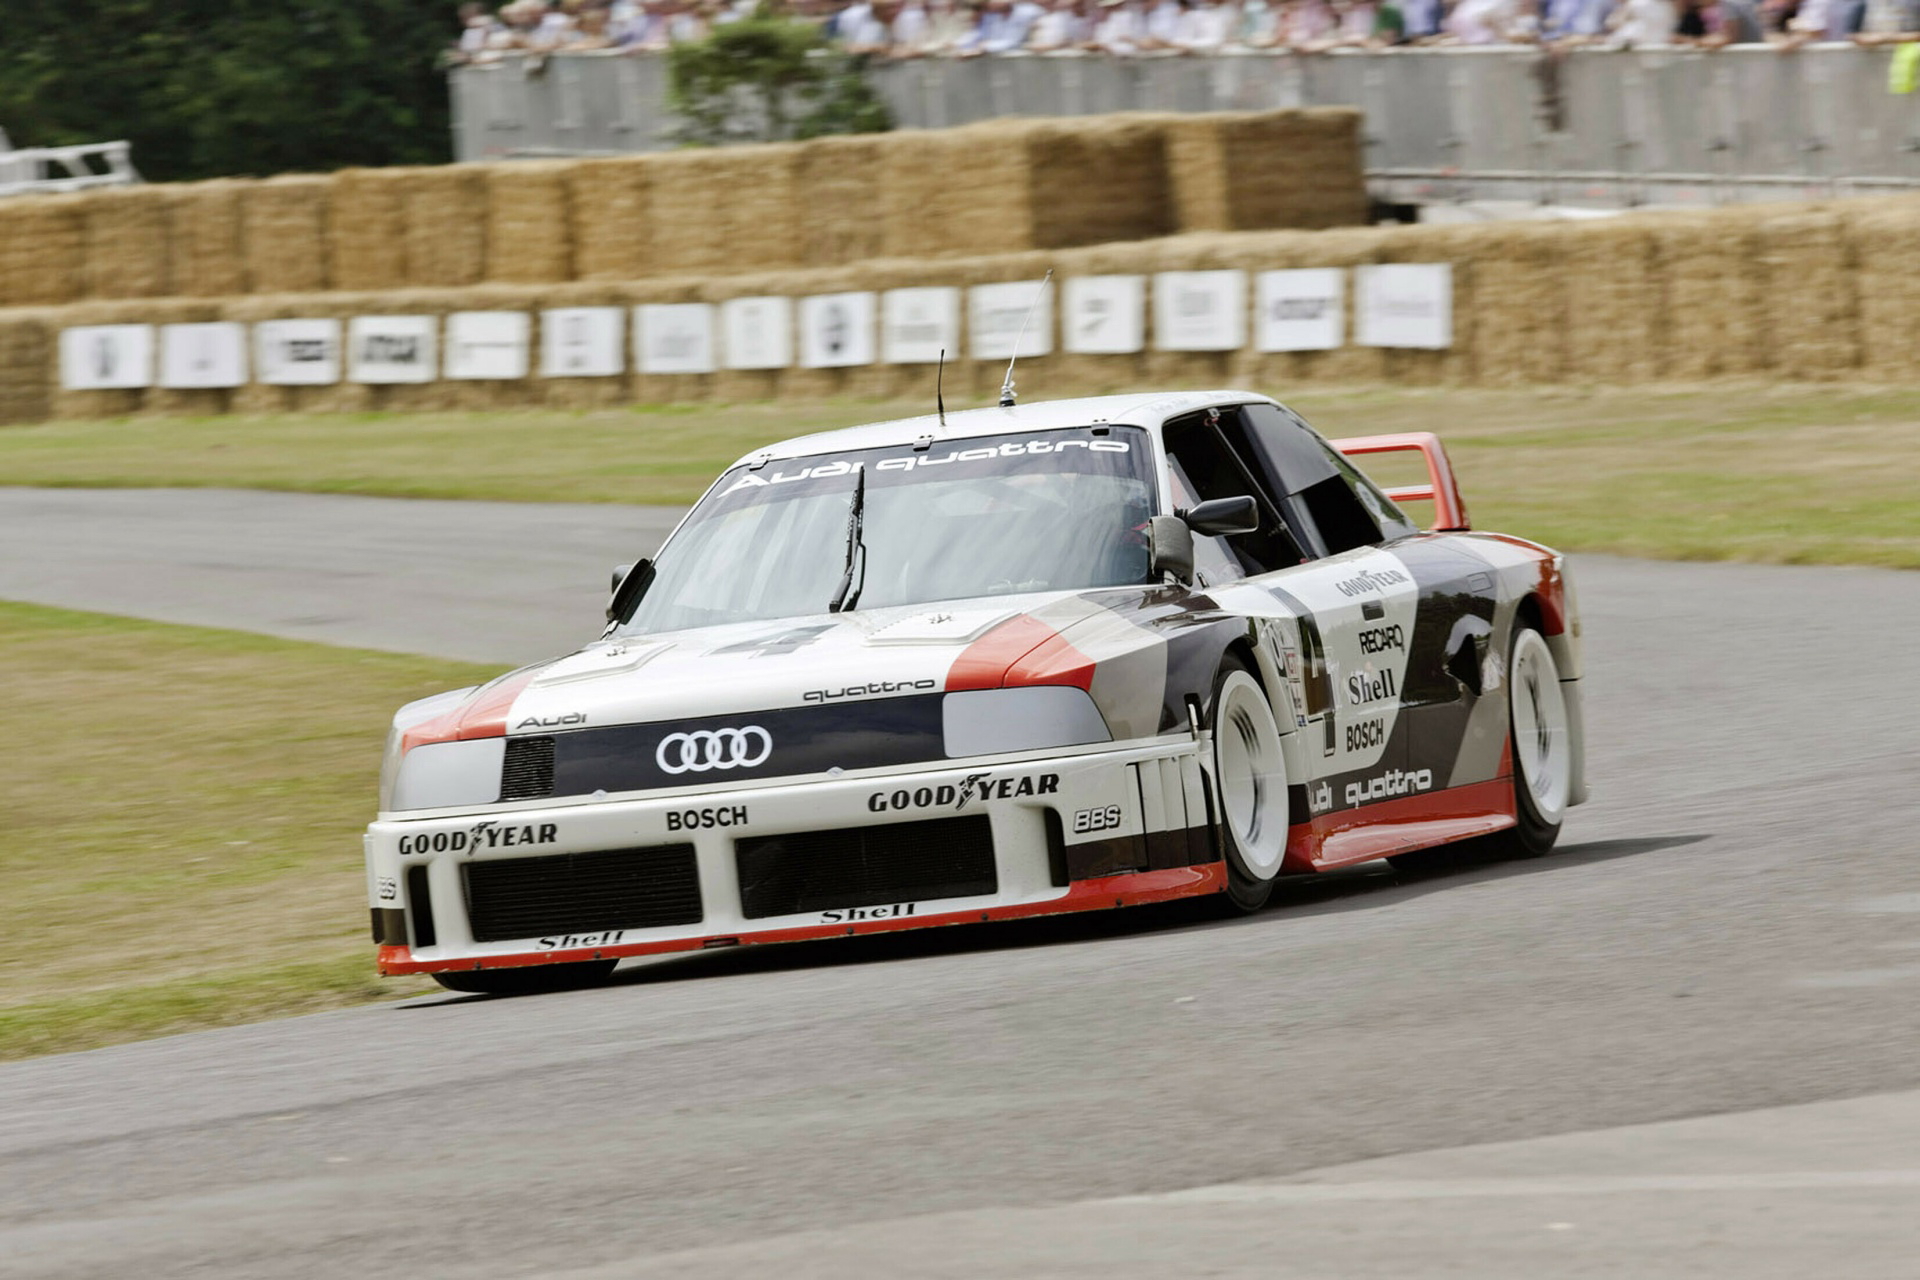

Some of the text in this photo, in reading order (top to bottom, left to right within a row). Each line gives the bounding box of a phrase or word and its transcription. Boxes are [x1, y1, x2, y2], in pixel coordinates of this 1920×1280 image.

[716, 440, 1130, 499] Audi quattro
[803, 679, 936, 703] quattro
[1348, 668, 1397, 706] Shell
[516, 712, 588, 730] Audi
[1346, 718, 1384, 753] BOSCH
[1345, 768, 1432, 810] quattro
[666, 805, 749, 832] BOSCH
[1073, 804, 1121, 834] BBS
[820, 903, 915, 924] Shell
[534, 930, 624, 951] Shell
